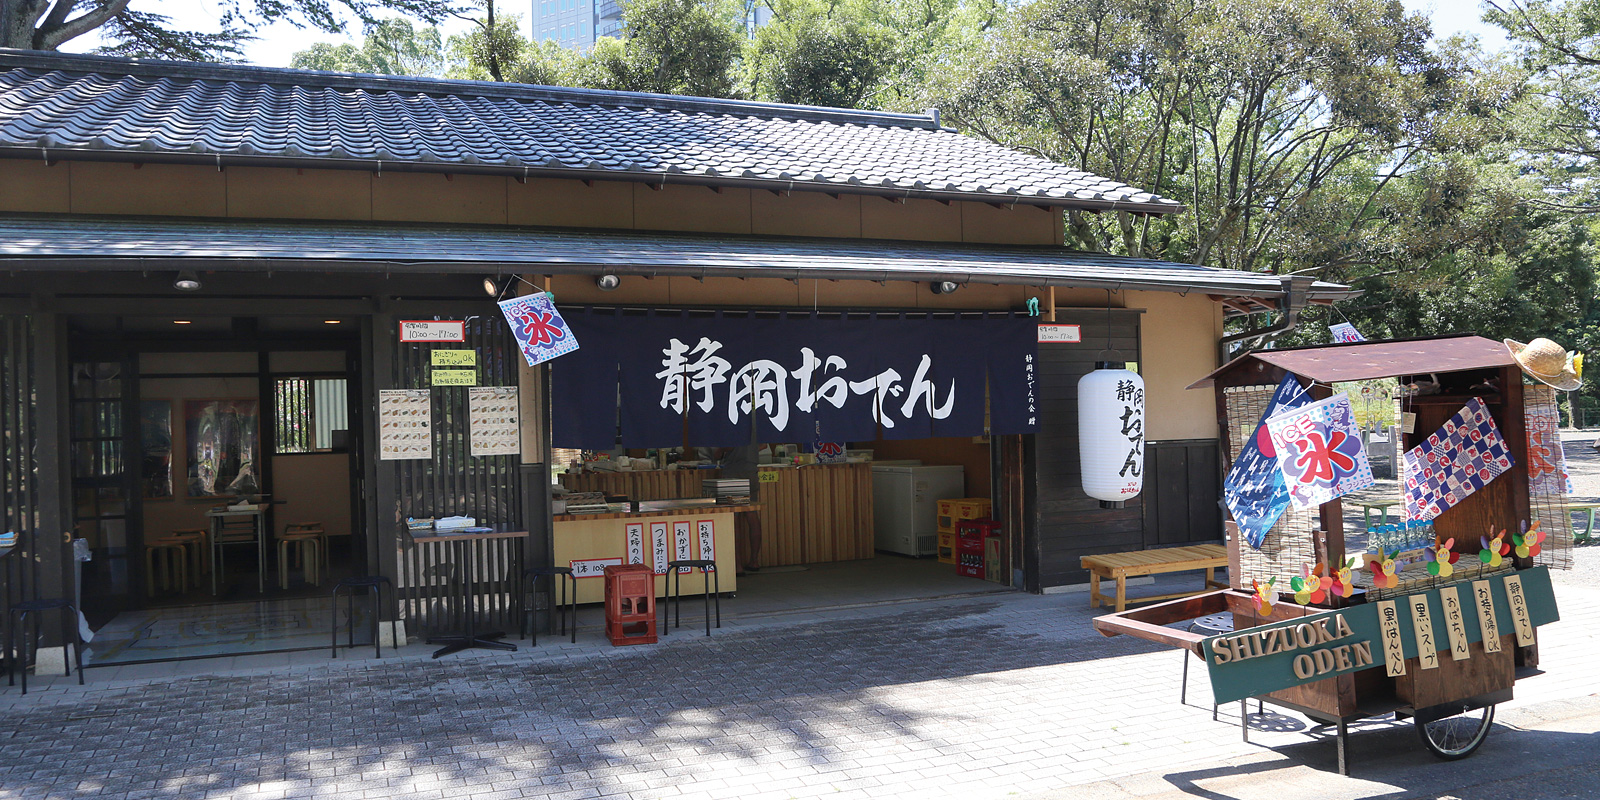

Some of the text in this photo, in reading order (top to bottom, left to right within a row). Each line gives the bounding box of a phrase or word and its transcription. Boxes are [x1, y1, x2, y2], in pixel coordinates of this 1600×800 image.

[505, 301, 531, 321] ICE
[520, 312, 563, 346] 氷
[655, 337, 955, 432] 静岡おでん
[1273, 414, 1316, 449] ICE
[1295, 431, 1354, 484] 氷
[1346, 478, 1373, 490] フジスコ
[1415, 603, 1435, 665] 黒いスープ
[1446, 597, 1466, 653] おばちゃん
[1508, 582, 1531, 640] 静岡おでん
[1211, 613, 1354, 665] SHIZUOKA
[1293, 640, 1374, 679] ODEN
[1383, 607, 1403, 674] 黒はんぺん
